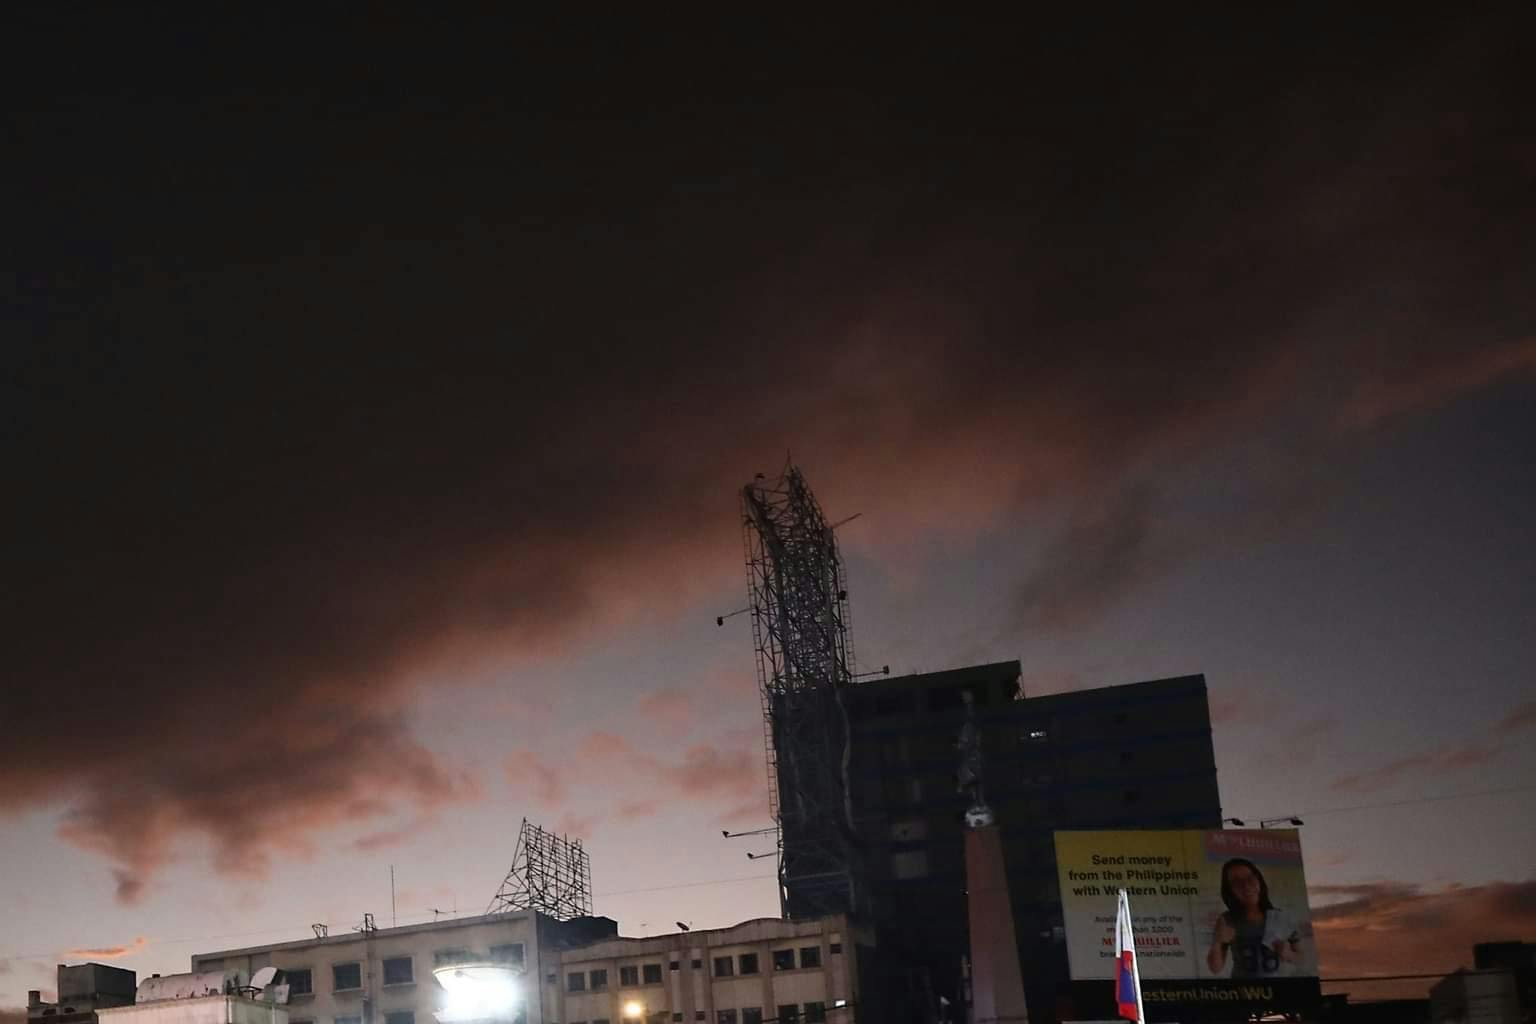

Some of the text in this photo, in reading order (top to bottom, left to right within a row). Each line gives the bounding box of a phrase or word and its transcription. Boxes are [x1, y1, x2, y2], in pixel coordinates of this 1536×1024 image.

[1092, 855, 1172, 867] Send money
[1068, 870, 1198, 882] from the Philippines
[1072, 885, 1101, 896] with
[1160, 885, 1198, 896] Union
